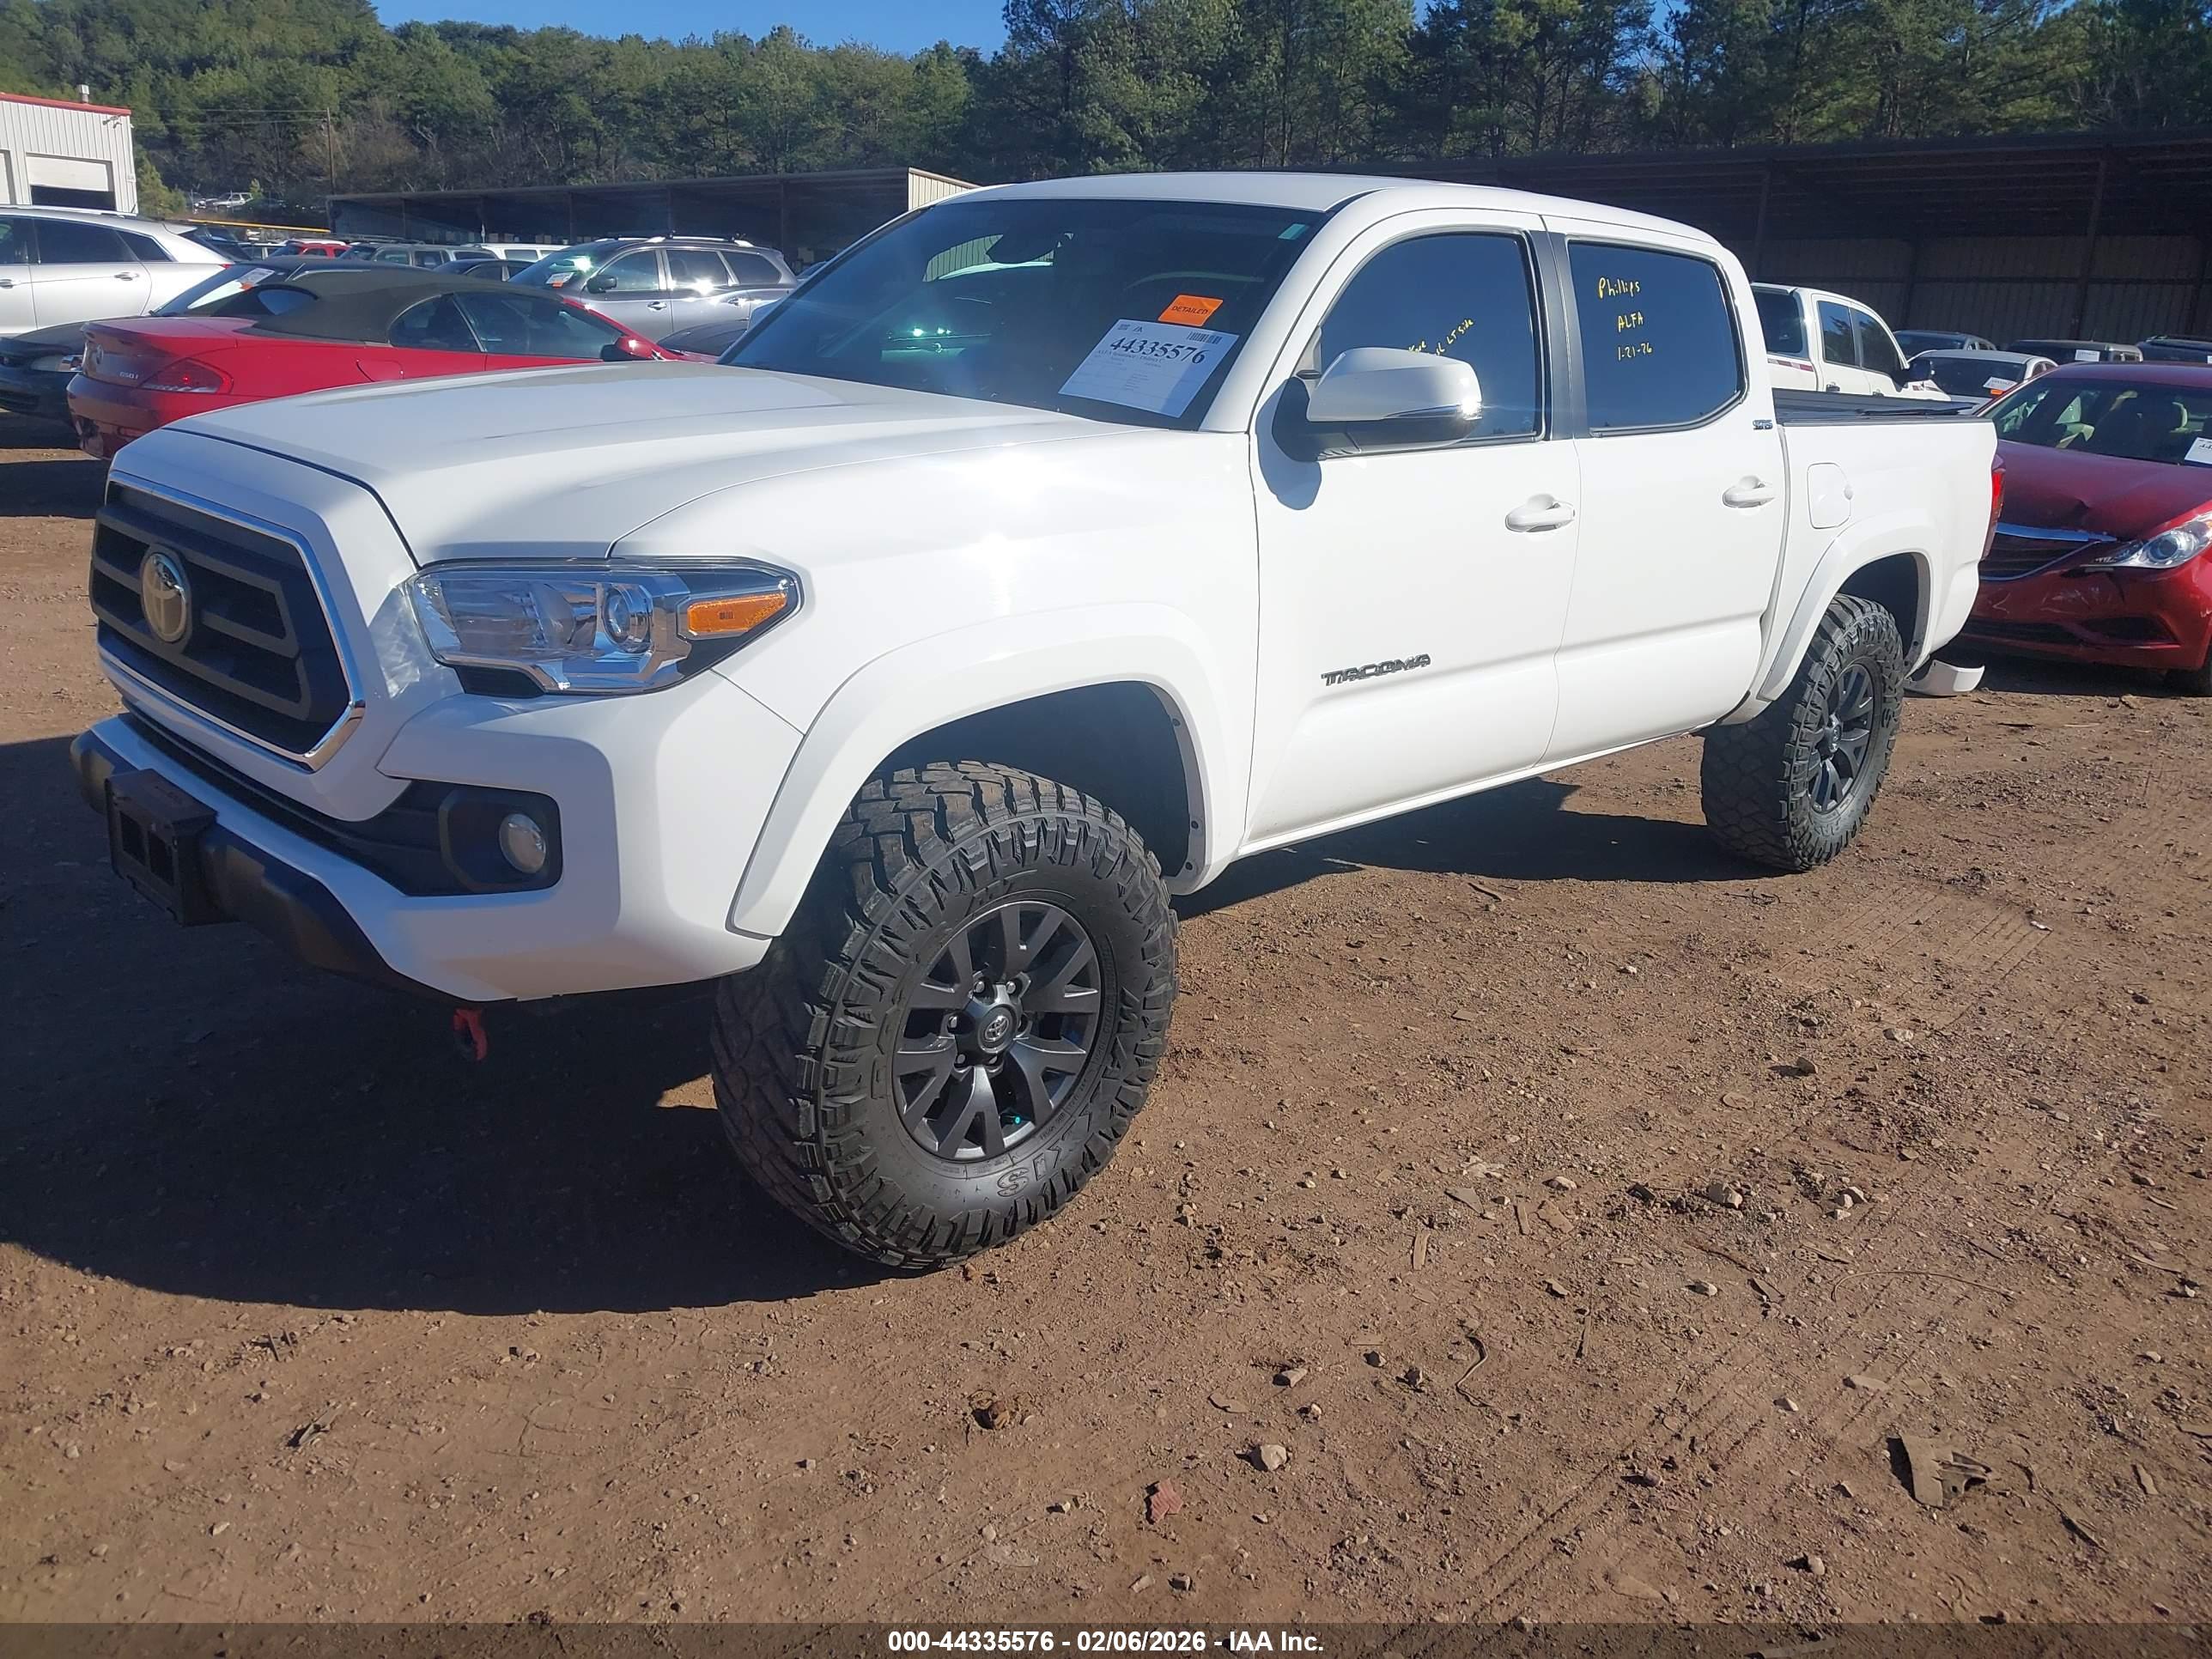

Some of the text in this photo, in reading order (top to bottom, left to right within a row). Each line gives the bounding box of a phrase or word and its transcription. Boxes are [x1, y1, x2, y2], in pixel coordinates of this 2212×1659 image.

[1599, 276, 1640, 299] Phillips
[1171, 306, 1208, 314] DETAILED
[1618, 311, 1643, 333] ALFA
[1110, 337, 1209, 364] 44335576
[1321, 653, 1431, 686] TACOMA
